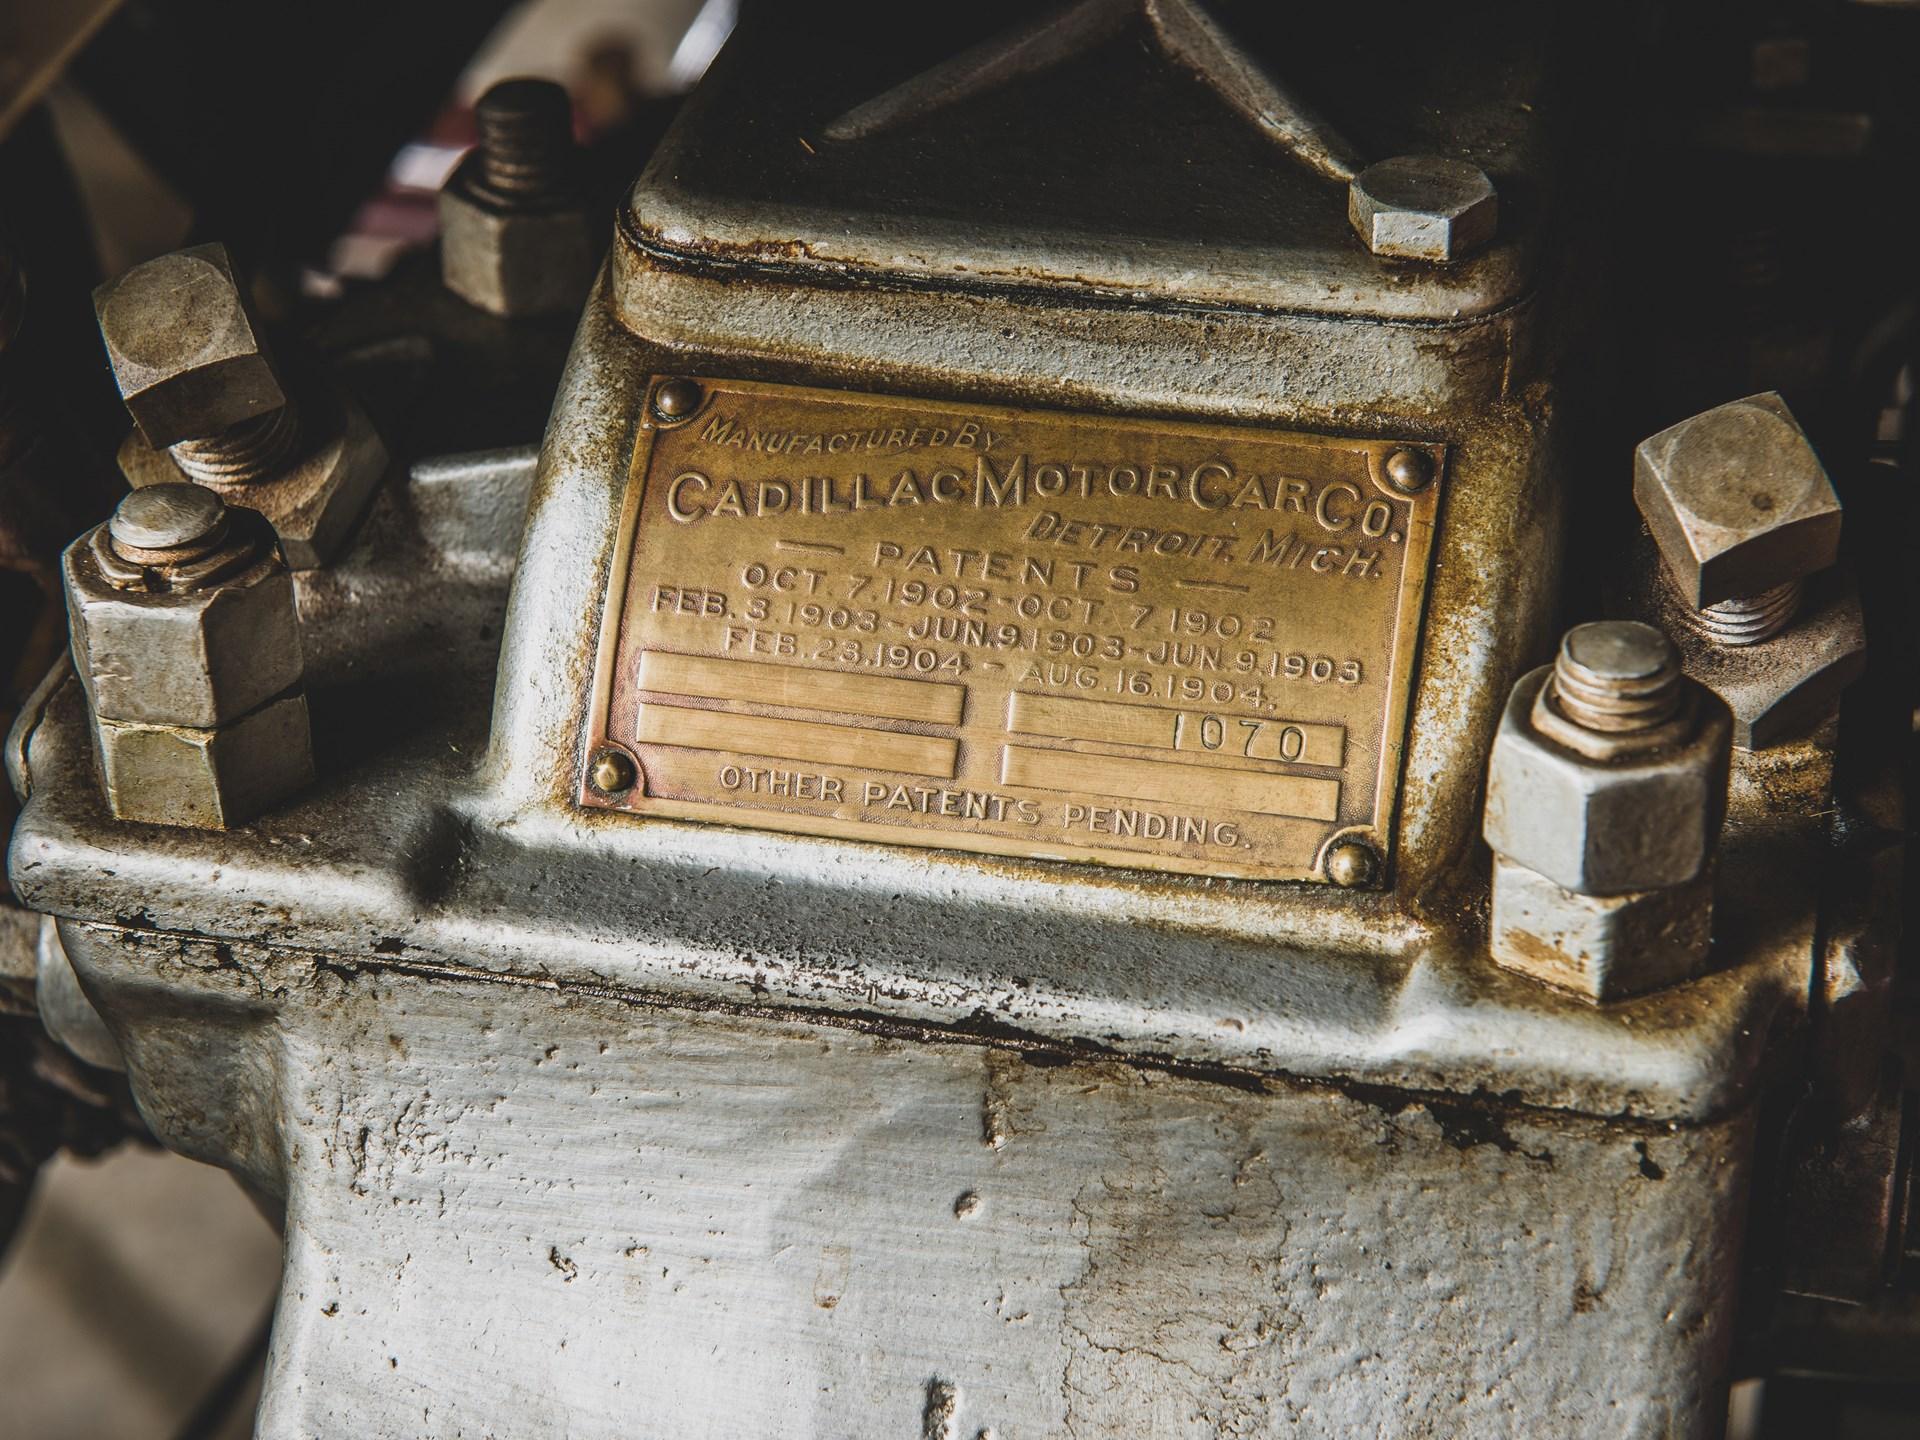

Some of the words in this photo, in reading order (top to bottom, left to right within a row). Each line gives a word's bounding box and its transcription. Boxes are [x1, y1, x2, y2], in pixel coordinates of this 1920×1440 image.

[702, 414, 947, 455] MANUFACTURED
[952, 421, 1004, 453] BY
[667, 466, 966, 523] CADILLAC
[974, 453, 1182, 510] MOTOR
[1189, 460, 1311, 514] CAR
[1315, 480, 1403, 543] CO.
[873, 540, 1140, 595] PATENTS
[1246, 528, 1383, 579] MICH.
[1172, 711, 1307, 763] 1070
[720, 764, 844, 803] OTHER
[864, 780, 1042, 826] PATENTS
[1063, 802, 1252, 850] PENDING.
